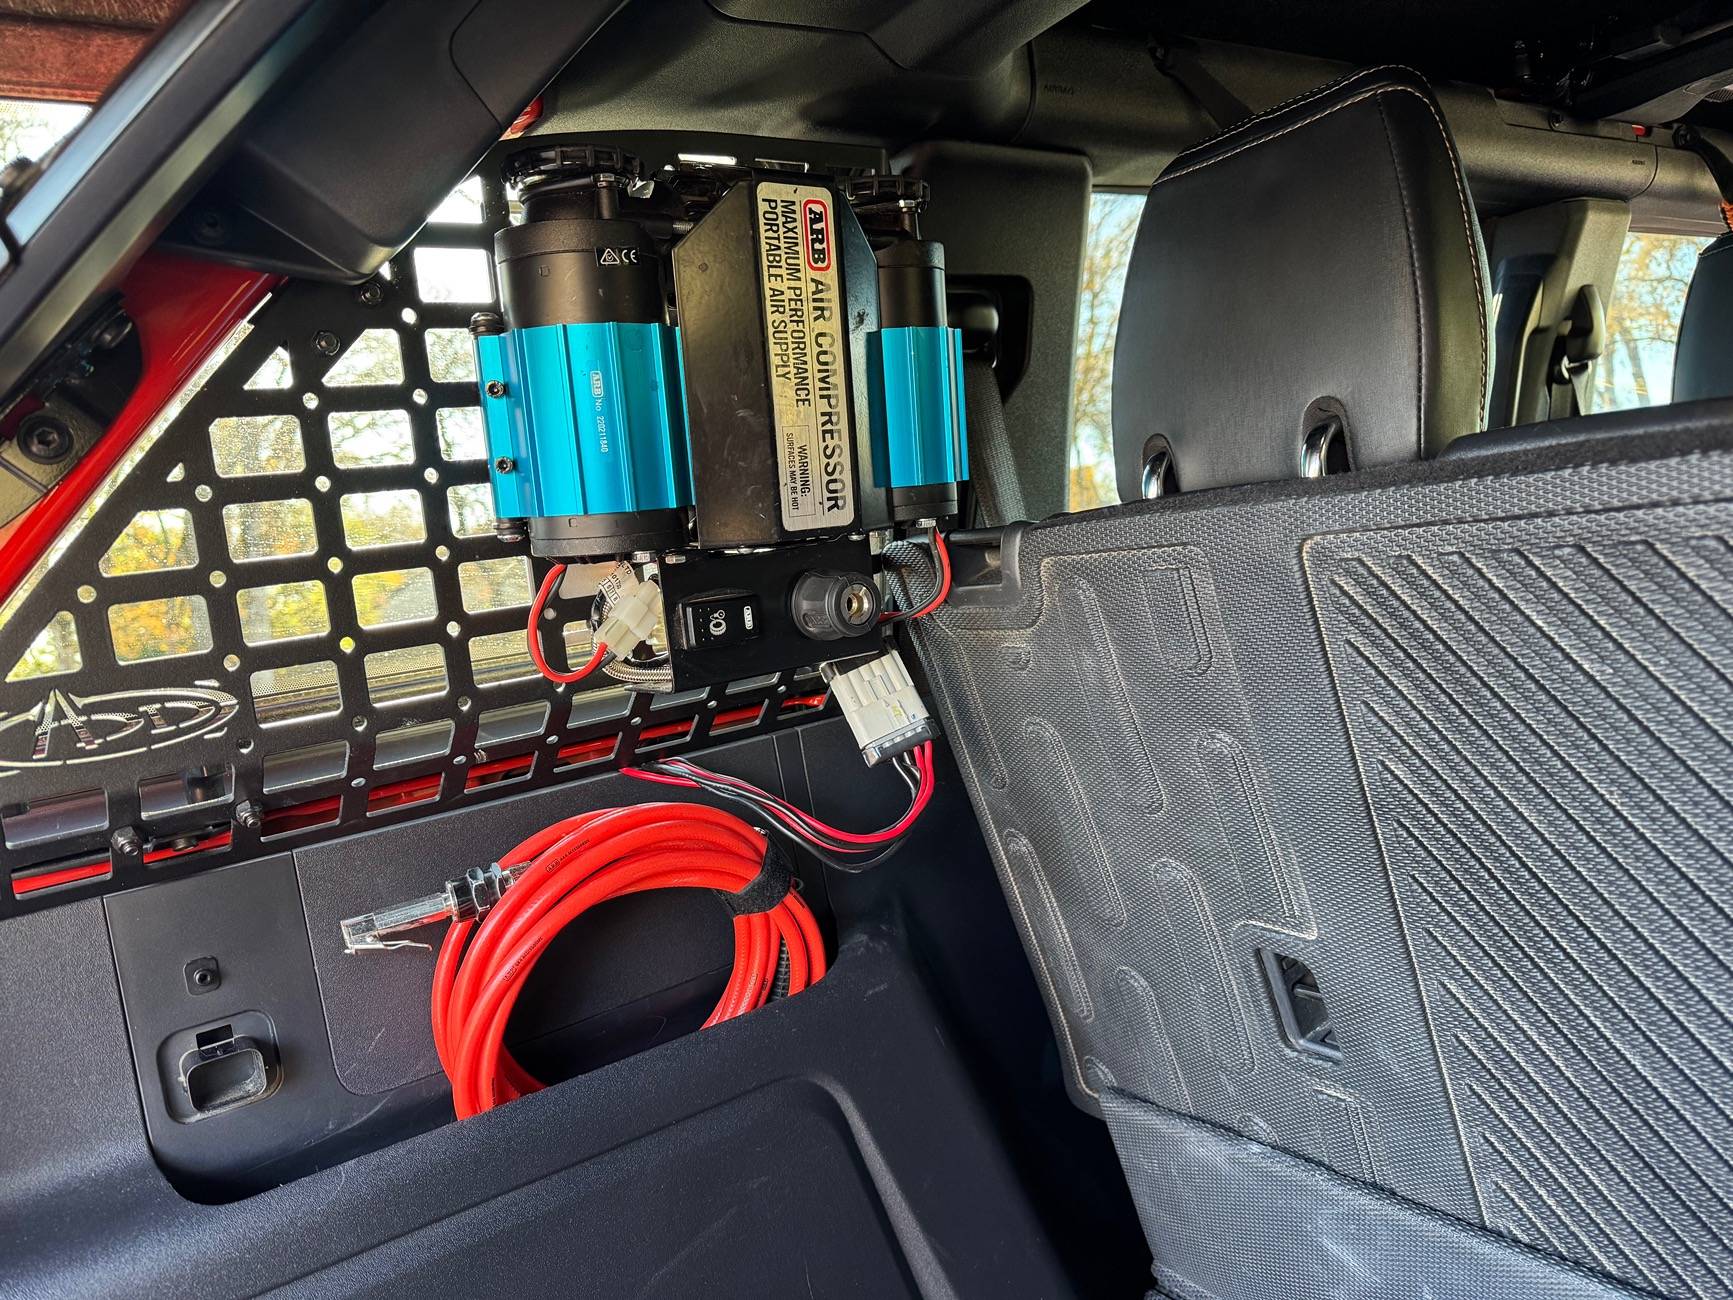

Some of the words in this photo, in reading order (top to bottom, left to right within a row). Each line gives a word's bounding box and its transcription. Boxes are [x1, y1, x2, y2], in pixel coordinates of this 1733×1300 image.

[761, 198, 784, 284] PORTABLE
[780, 199, 802, 282] MAXIMUM
[808, 206, 827, 265] ARB
[768, 287, 786, 316] AIR
[811, 277, 833, 323] AIR
[772, 319, 791, 382] SUPPLY
[787, 286, 811, 408] PERFORMANCE
[592, 371, 603, 396] ARB
[814, 331, 847, 513] COMPRESSOR
[786, 432, 796, 469] SURFACES
[797, 444, 812, 498] WARNING:
[789, 469, 798, 485] MAY
[791, 486, 798, 496] BE
[792, 497, 800, 511] HOT
